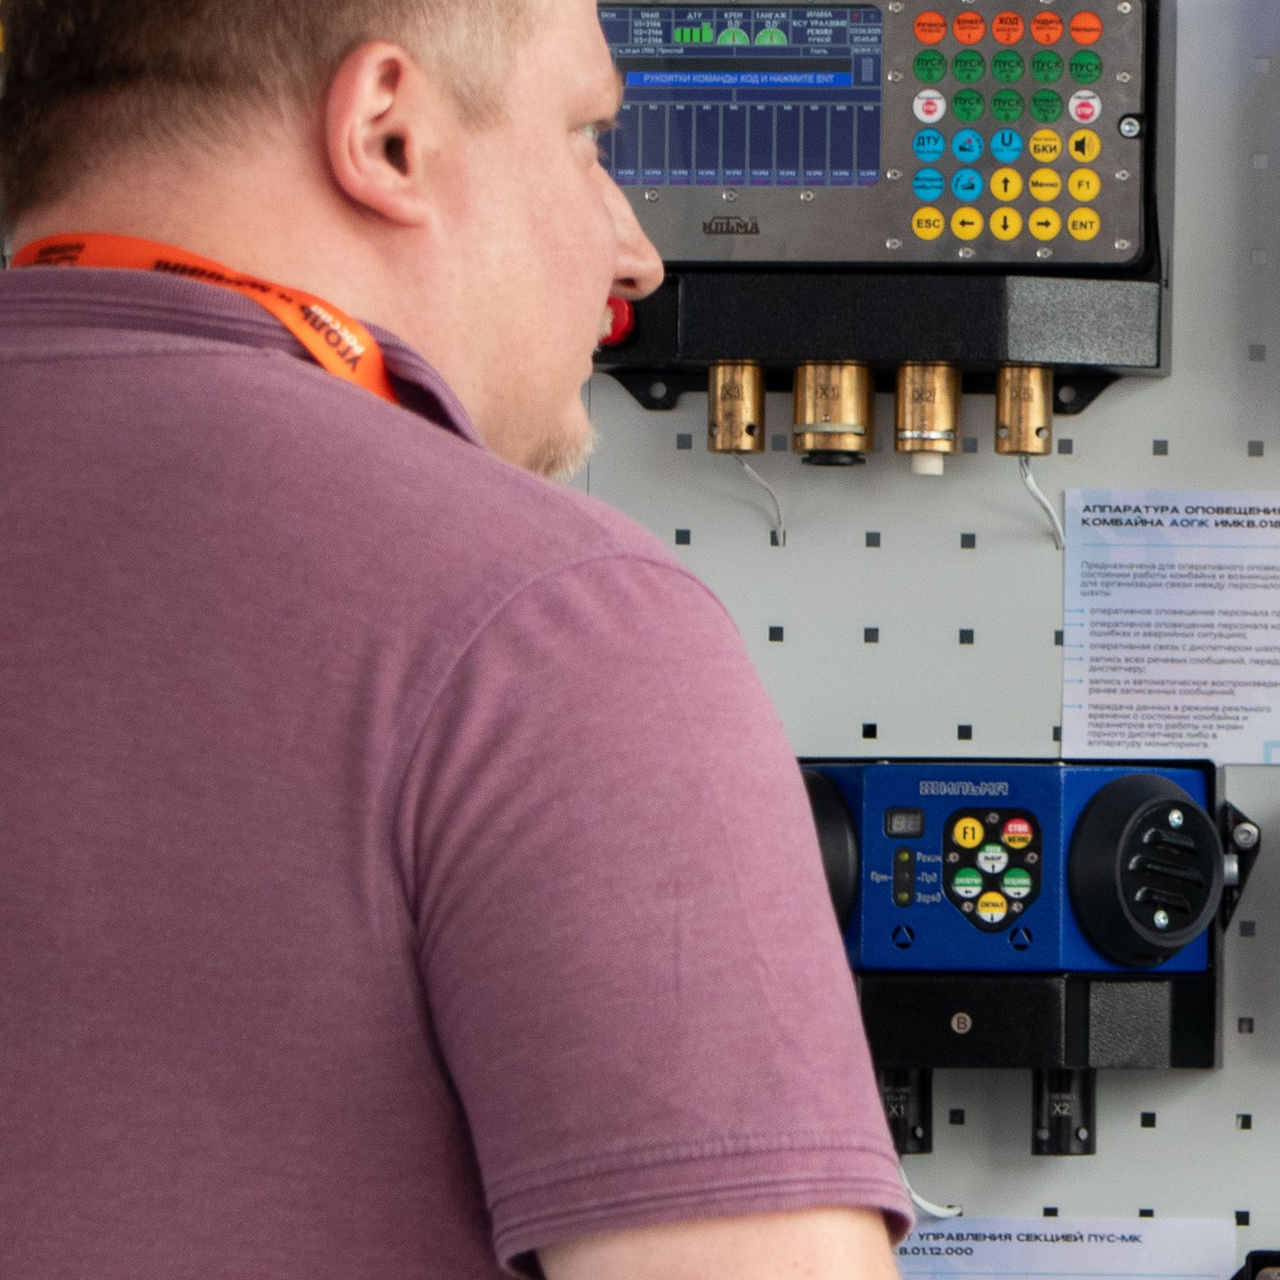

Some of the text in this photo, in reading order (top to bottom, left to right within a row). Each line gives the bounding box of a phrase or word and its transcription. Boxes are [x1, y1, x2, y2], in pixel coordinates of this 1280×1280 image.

[916, 136, 940, 147] ДТУ
[1033, 144, 1057, 154] БКИ
[1077, 181, 1091, 189] F1
[917, 219, 940, 228] ESC
[1071, 221, 1095, 230] ENT
[1083, 505, 1179, 514] АППАРАТУРА
[1082, 517, 1164, 527] КОМБАЙНА
[1170, 520, 1209, 528] АОПК
[962, 826, 976, 840] F1
[1053, 1103, 1070, 1116] X2
[918, 1230, 1142, 1244] УПРАВЛЕНИЯ СЕКЦИЕЙ ПУС-МК
[897, 1246, 973, 1256] В.01.12.000
